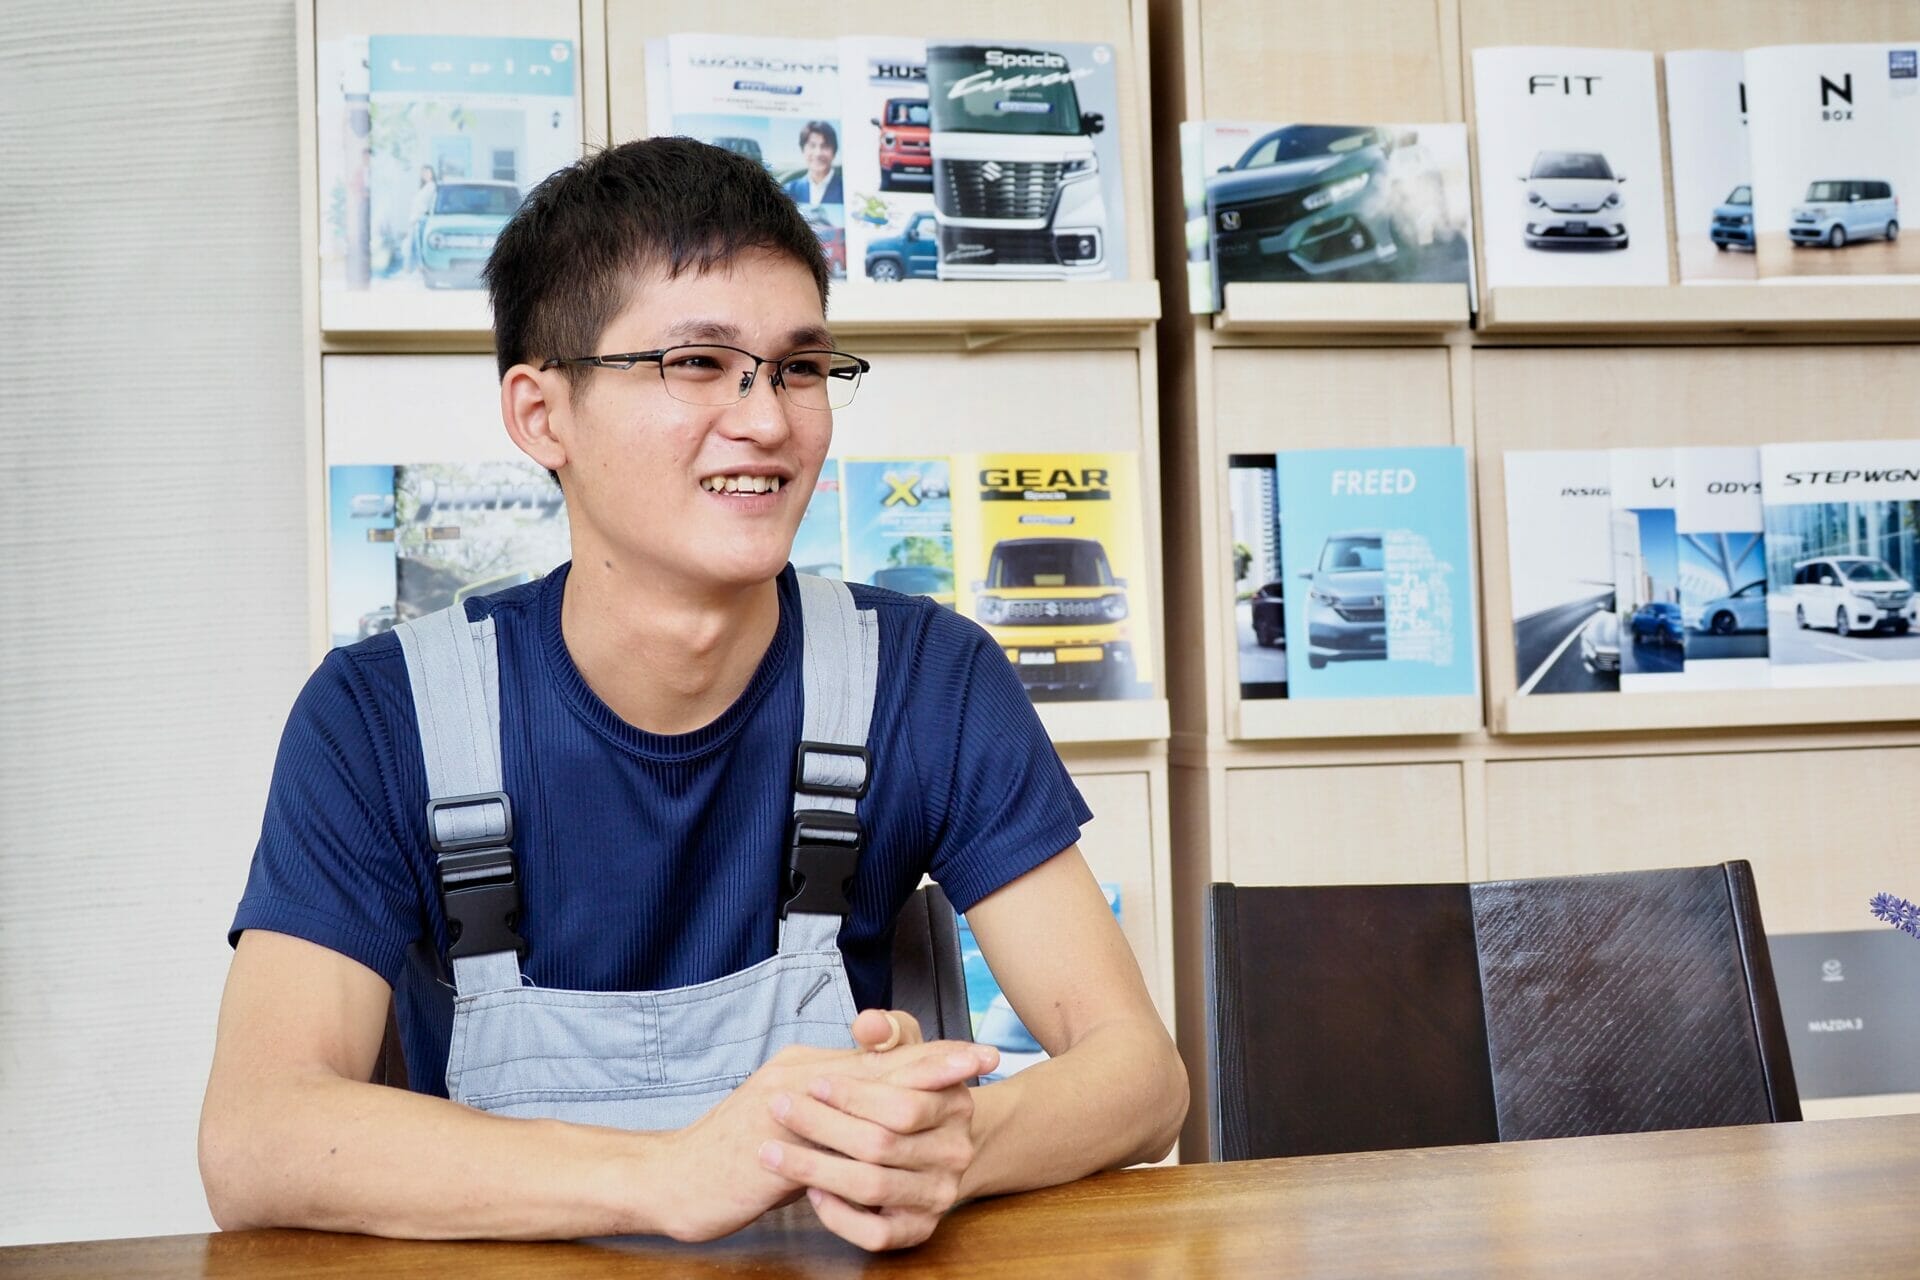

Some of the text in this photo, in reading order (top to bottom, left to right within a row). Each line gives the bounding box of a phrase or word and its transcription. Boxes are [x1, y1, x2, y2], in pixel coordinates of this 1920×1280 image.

[984, 50, 1064, 69] Spacia
[1529, 74, 1602, 95] FIT
[1820, 73, 1853, 107] N
[1822, 110, 1853, 121] BOX
[979, 469, 1108, 487] GEAR
[1331, 468, 1417, 496] FREED
[1784, 469, 1920, 486] STEPWGN
